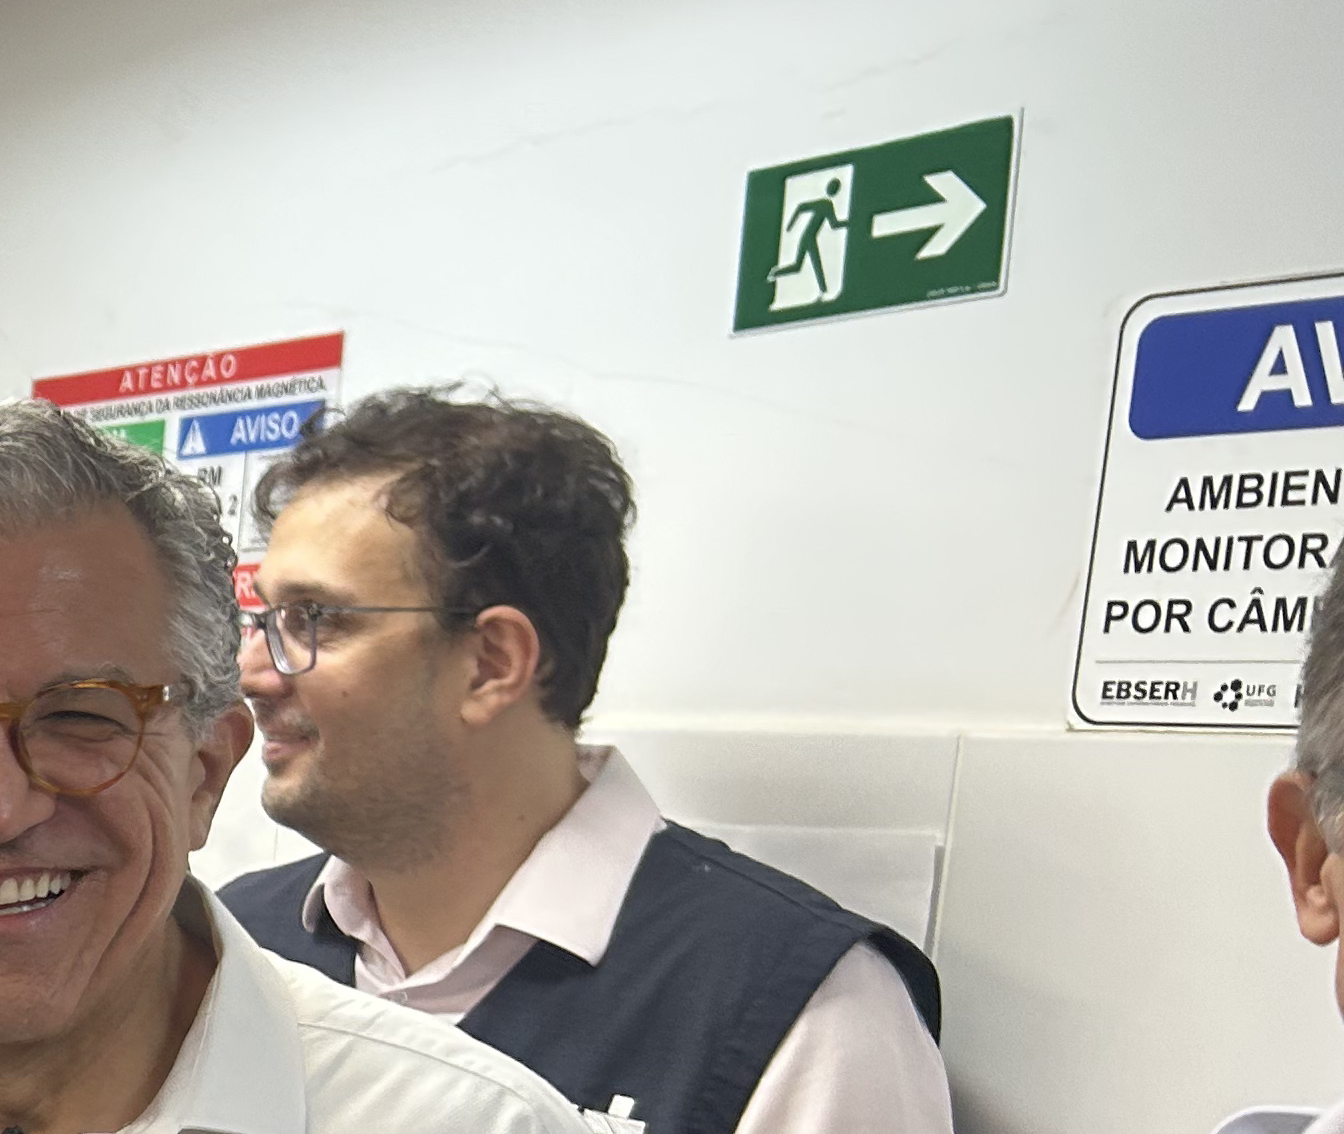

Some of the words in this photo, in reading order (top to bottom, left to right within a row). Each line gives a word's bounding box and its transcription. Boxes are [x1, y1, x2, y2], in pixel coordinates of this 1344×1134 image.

[118, 352, 238, 394] ATENÇÃO
[230, 410, 300, 446] AVISO
[1165, 467, 1343, 513] AMBIEN
[1123, 533, 1329, 575] MONITOR
[1102, 598, 1193, 634] POR
[1207, 586, 1308, 634] CÂM
[1100, 680, 1198, 701] EBSERH
[1245, 684, 1277, 698] UFG
